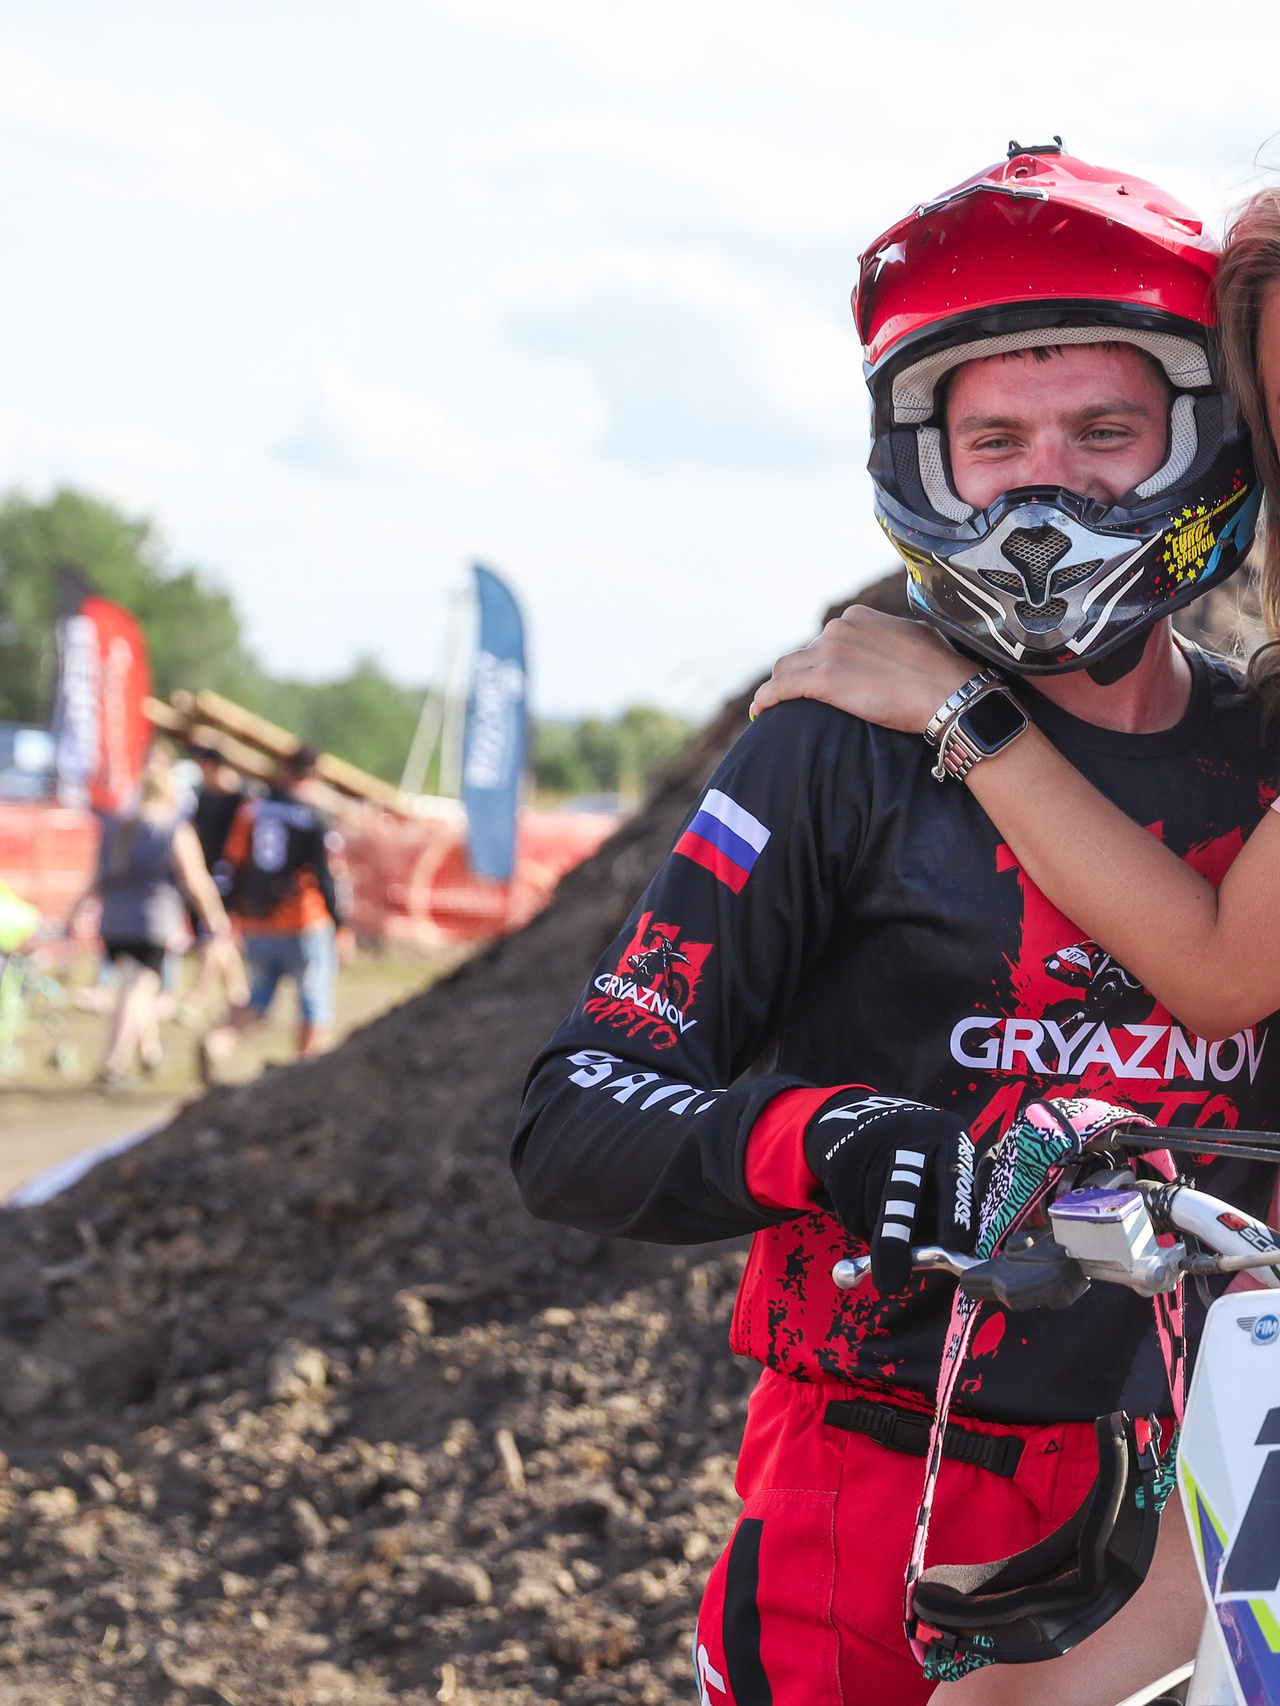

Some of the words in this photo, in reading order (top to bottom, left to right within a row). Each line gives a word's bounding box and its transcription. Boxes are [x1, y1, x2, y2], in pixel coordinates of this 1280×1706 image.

[1172, 522, 1205, 559] EURO
[582, 996, 677, 1051] MOTO
[594, 973, 697, 1034] GRYAZNOV
[949, 1016, 1269, 1085] GRYAZNOV
[969, 1081, 1239, 1167] MTO
[953, 1131, 976, 1231] FASTHOUSE
[1238, 1226, 1280, 1252] SC
[1256, 1319, 1279, 1336] FIM
